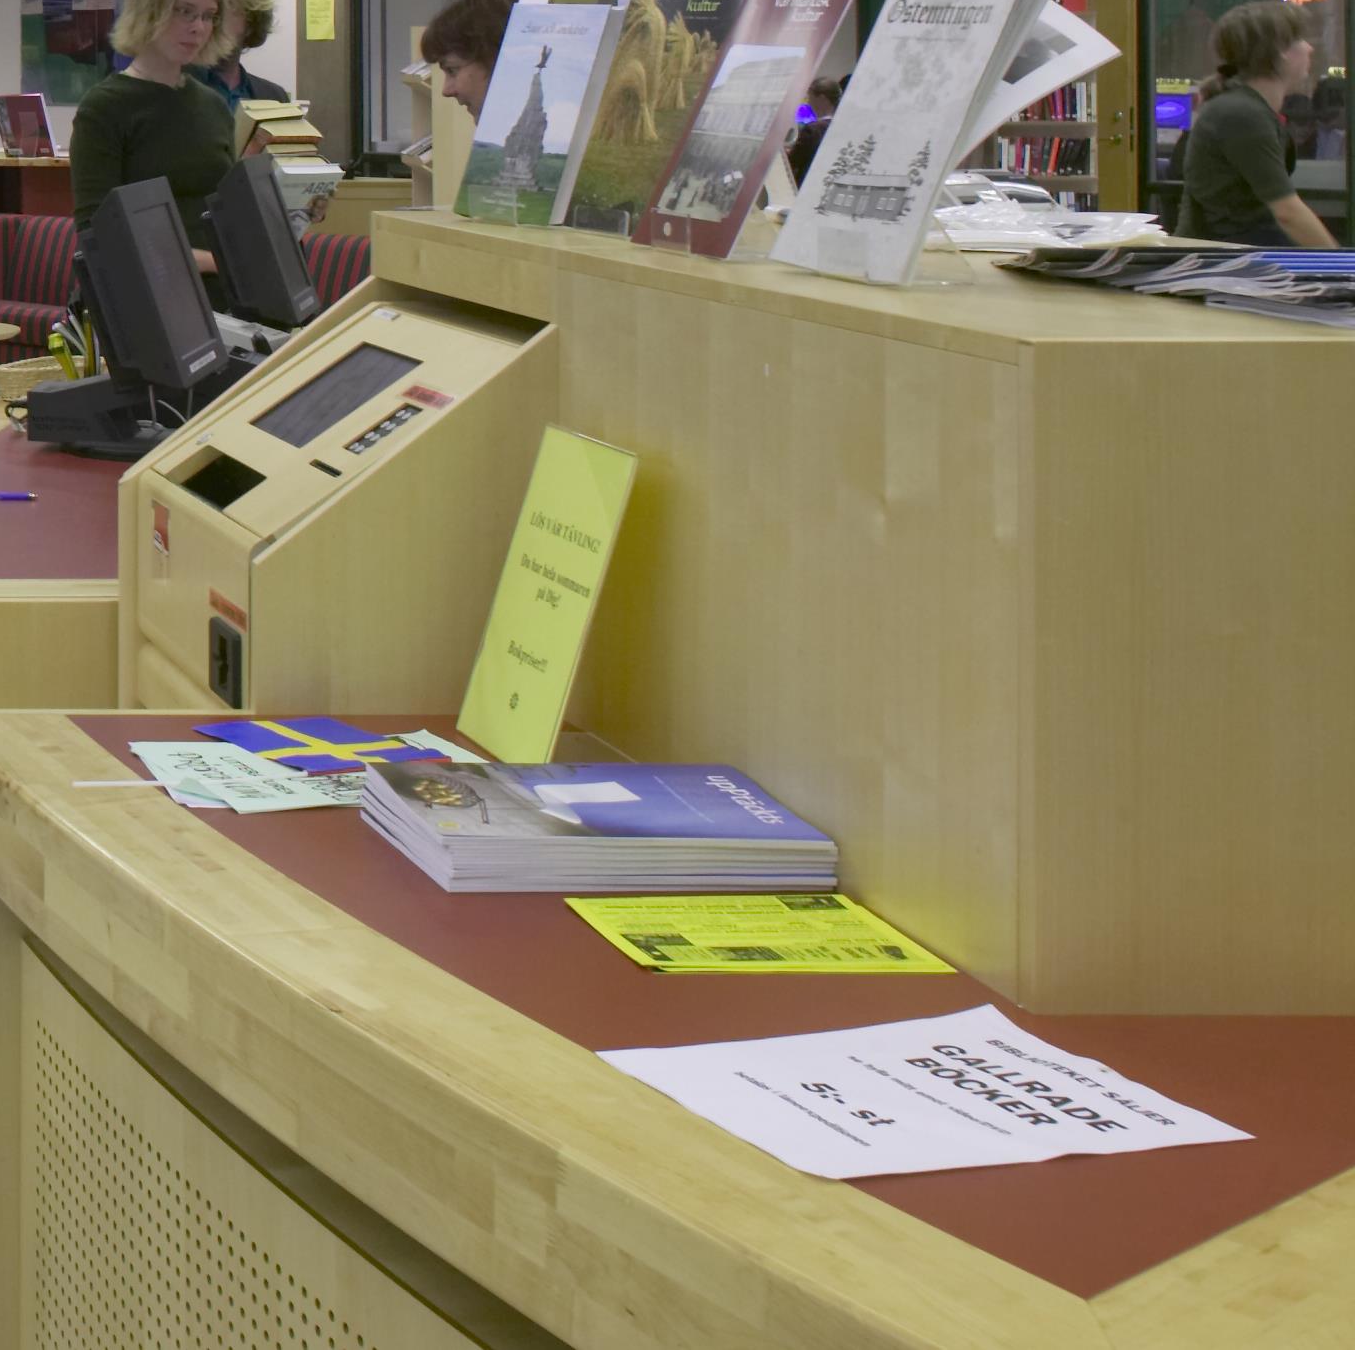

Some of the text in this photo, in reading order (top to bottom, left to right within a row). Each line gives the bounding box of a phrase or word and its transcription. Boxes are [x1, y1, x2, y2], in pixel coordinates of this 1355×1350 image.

[850, 1108, 897, 1129] st
[905, 1056, 1059, 1127] BÖCKER
[932, 1044, 1130, 1133] GALLRADE
[986, 1039, 1176, 1127] BIBLIOTEKET SÄLJER
